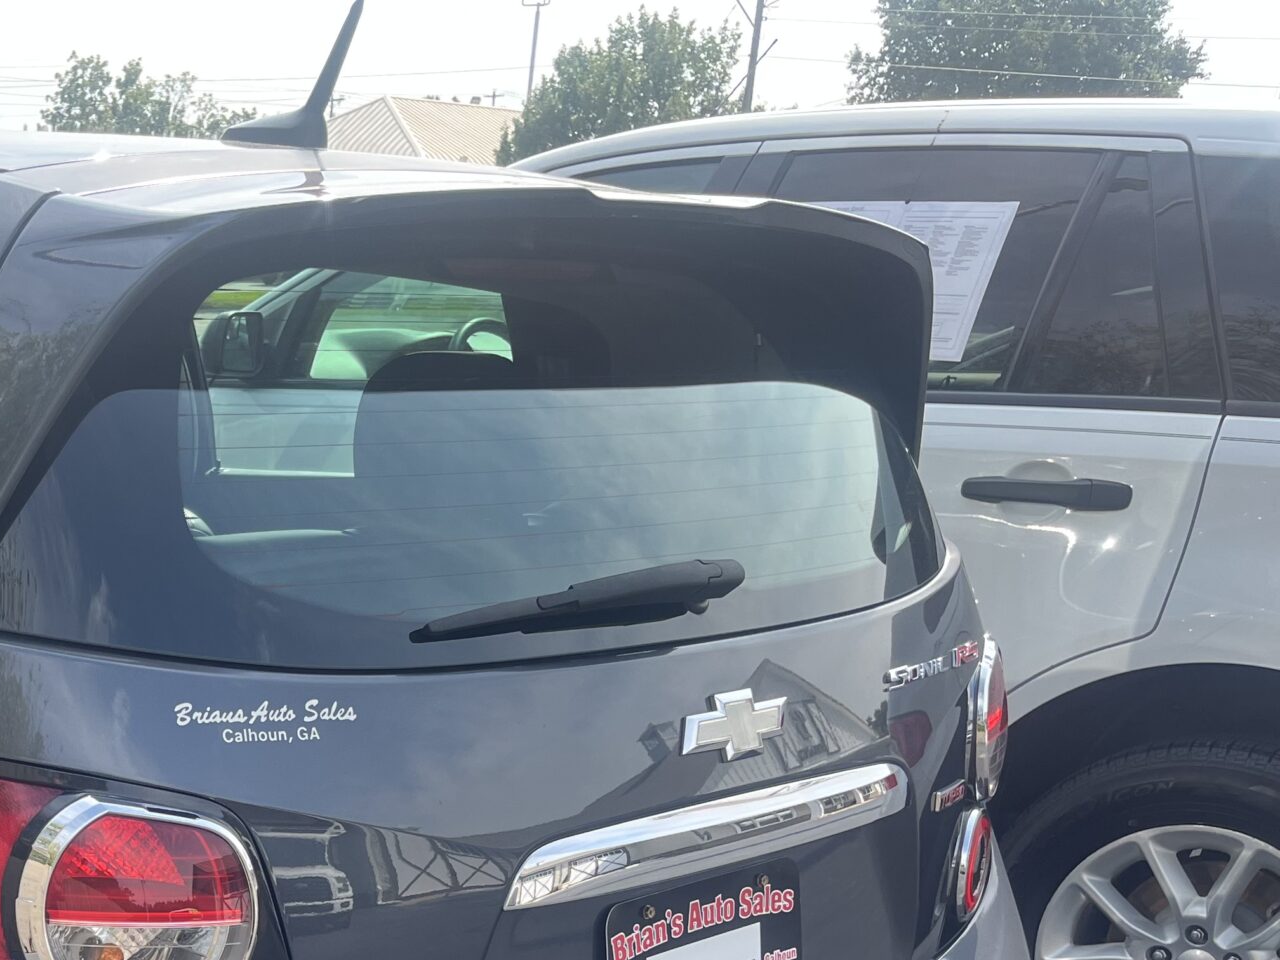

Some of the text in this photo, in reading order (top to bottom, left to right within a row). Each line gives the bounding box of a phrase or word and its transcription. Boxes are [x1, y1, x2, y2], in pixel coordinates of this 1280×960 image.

[883, 656, 949, 691] SONIC
[248, 700, 296, 724] Auto
[303, 699, 357, 723] Sales
[222, 727, 320, 743] Calhoun, GA
[687, 893, 735, 933] Auto
[739, 884, 794, 919] Sales
